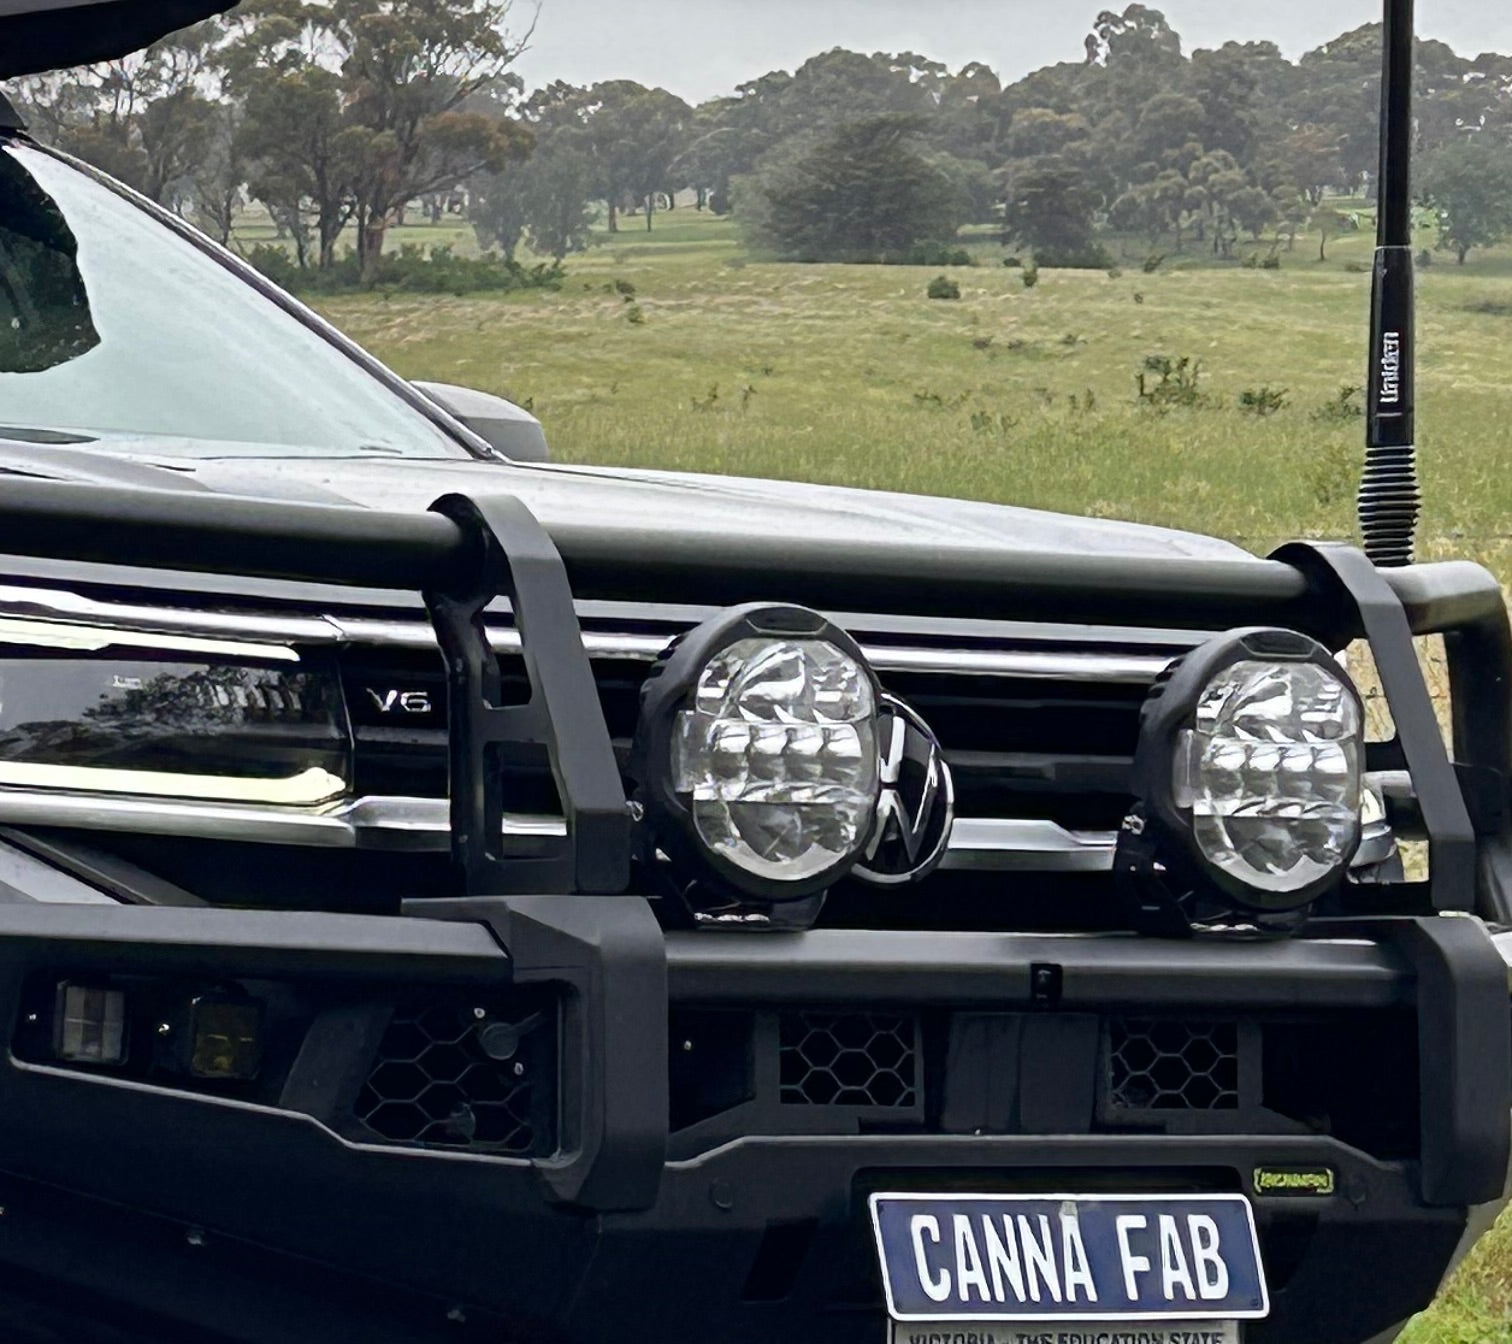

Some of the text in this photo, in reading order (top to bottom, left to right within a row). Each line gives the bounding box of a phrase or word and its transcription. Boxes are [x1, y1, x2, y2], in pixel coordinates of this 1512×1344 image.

[366, 687, 432, 712] V6
[910, 1213, 1230, 1303] CANNA FAB
